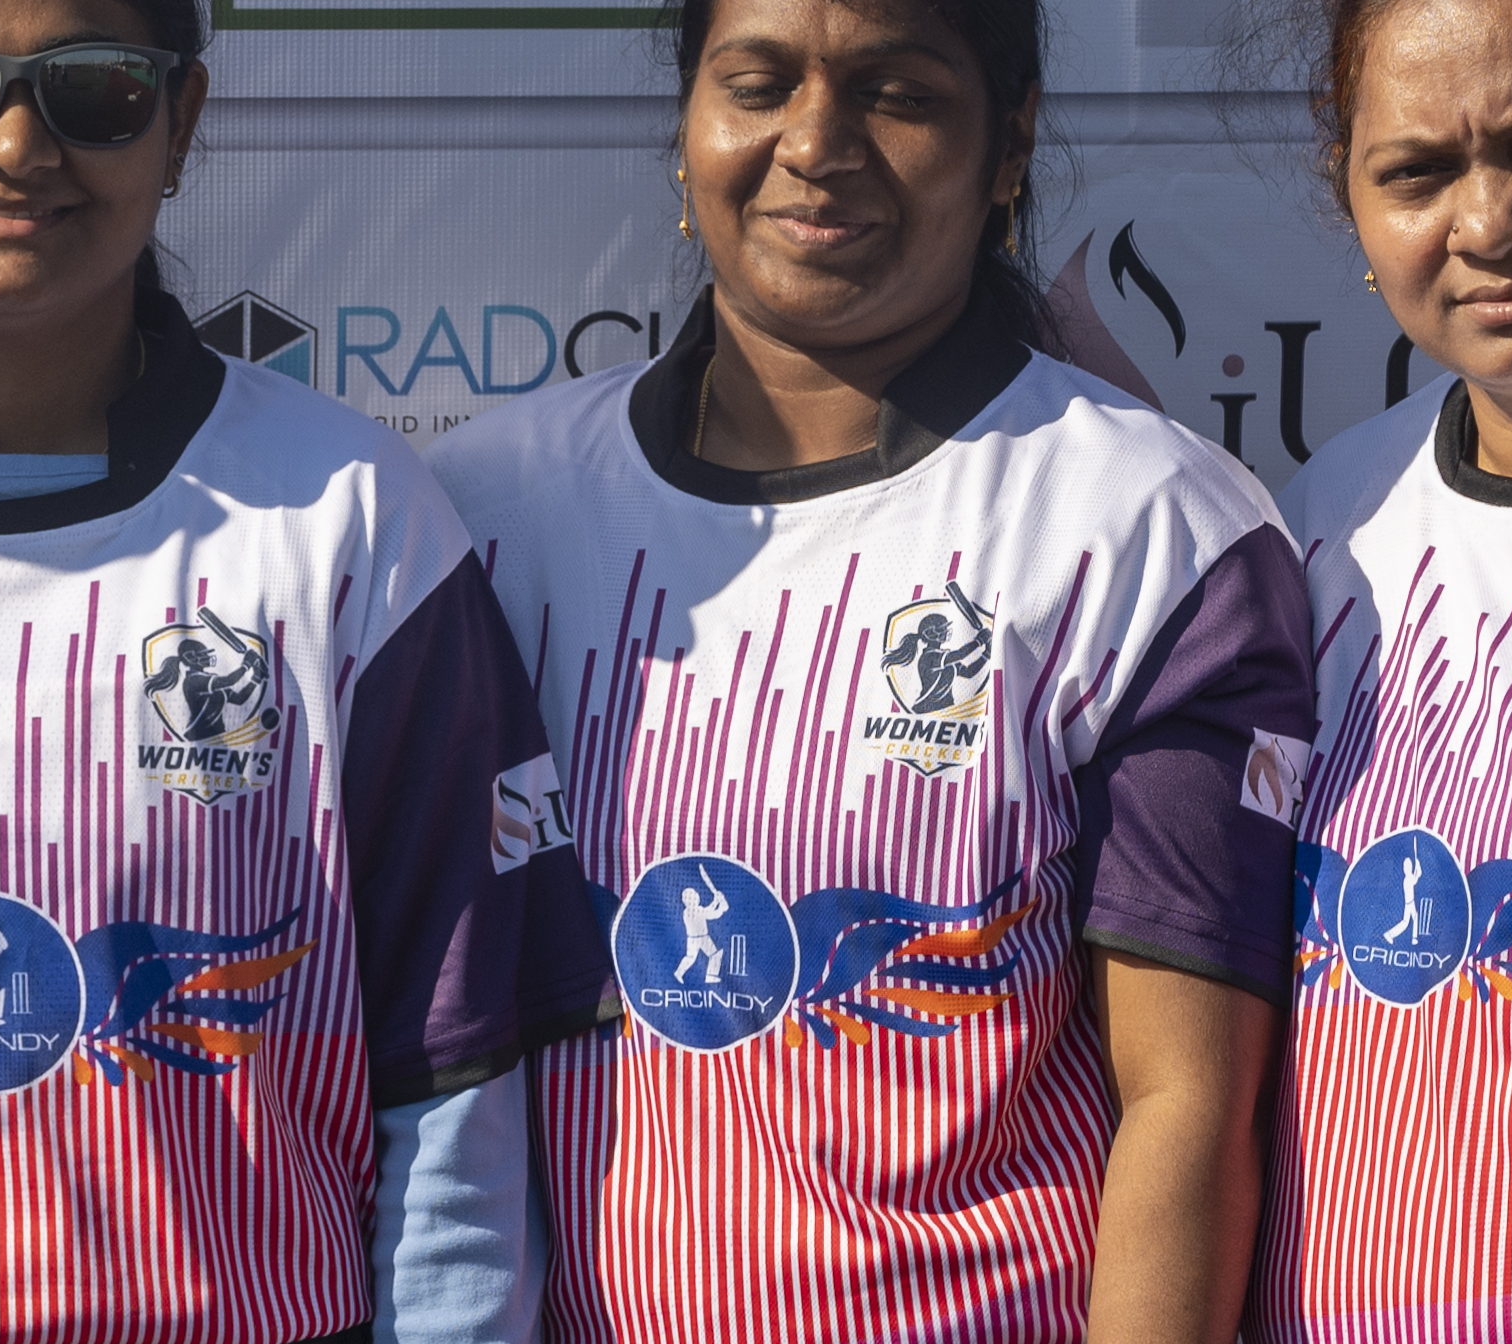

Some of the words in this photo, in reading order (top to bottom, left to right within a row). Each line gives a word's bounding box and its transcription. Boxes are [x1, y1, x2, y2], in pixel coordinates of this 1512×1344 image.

[138, 745, 273, 776] WOMEN'S
[885, 743, 974, 761] CRICKET
[162, 773, 248, 789] CRICKET
[1352, 944, 1454, 971] CRICINDY
[640, 987, 776, 1014] CRICINDY
